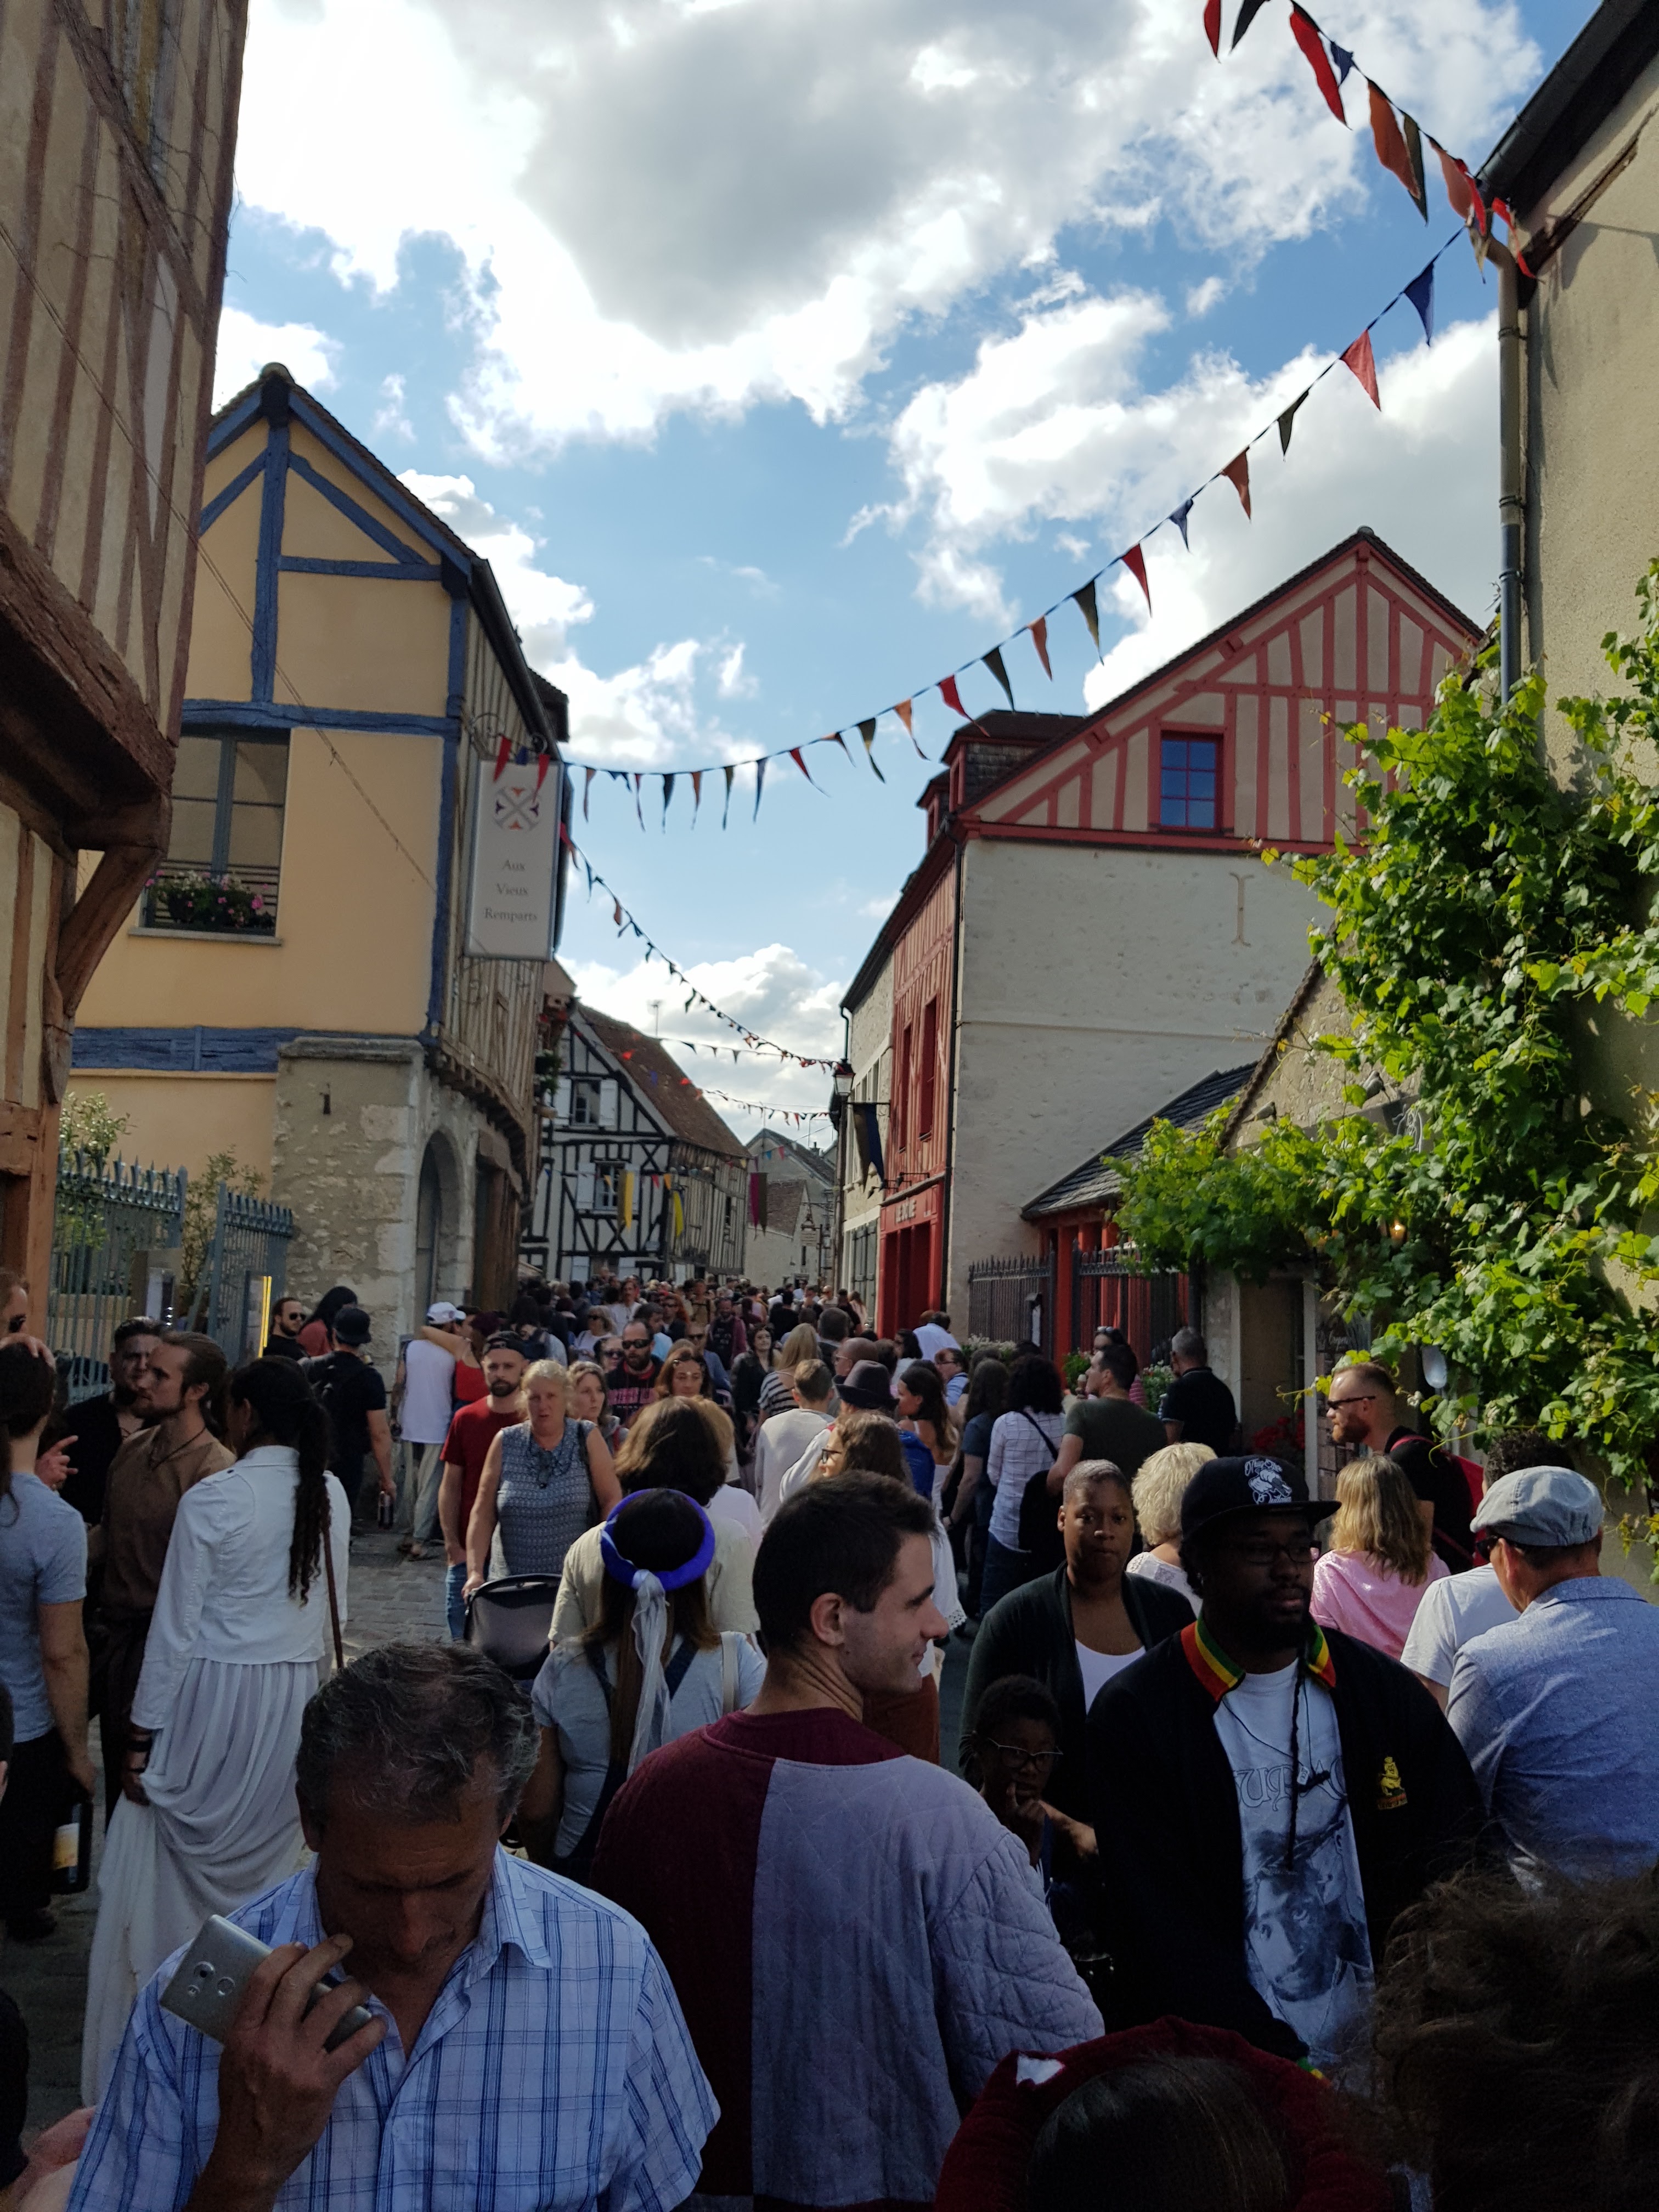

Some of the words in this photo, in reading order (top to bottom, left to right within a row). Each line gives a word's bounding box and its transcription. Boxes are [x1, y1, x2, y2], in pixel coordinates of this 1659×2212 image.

[502, 860, 526, 871] Aux
[495, 882, 528, 896] Vieux
[483, 906, 538, 922] Remparts
